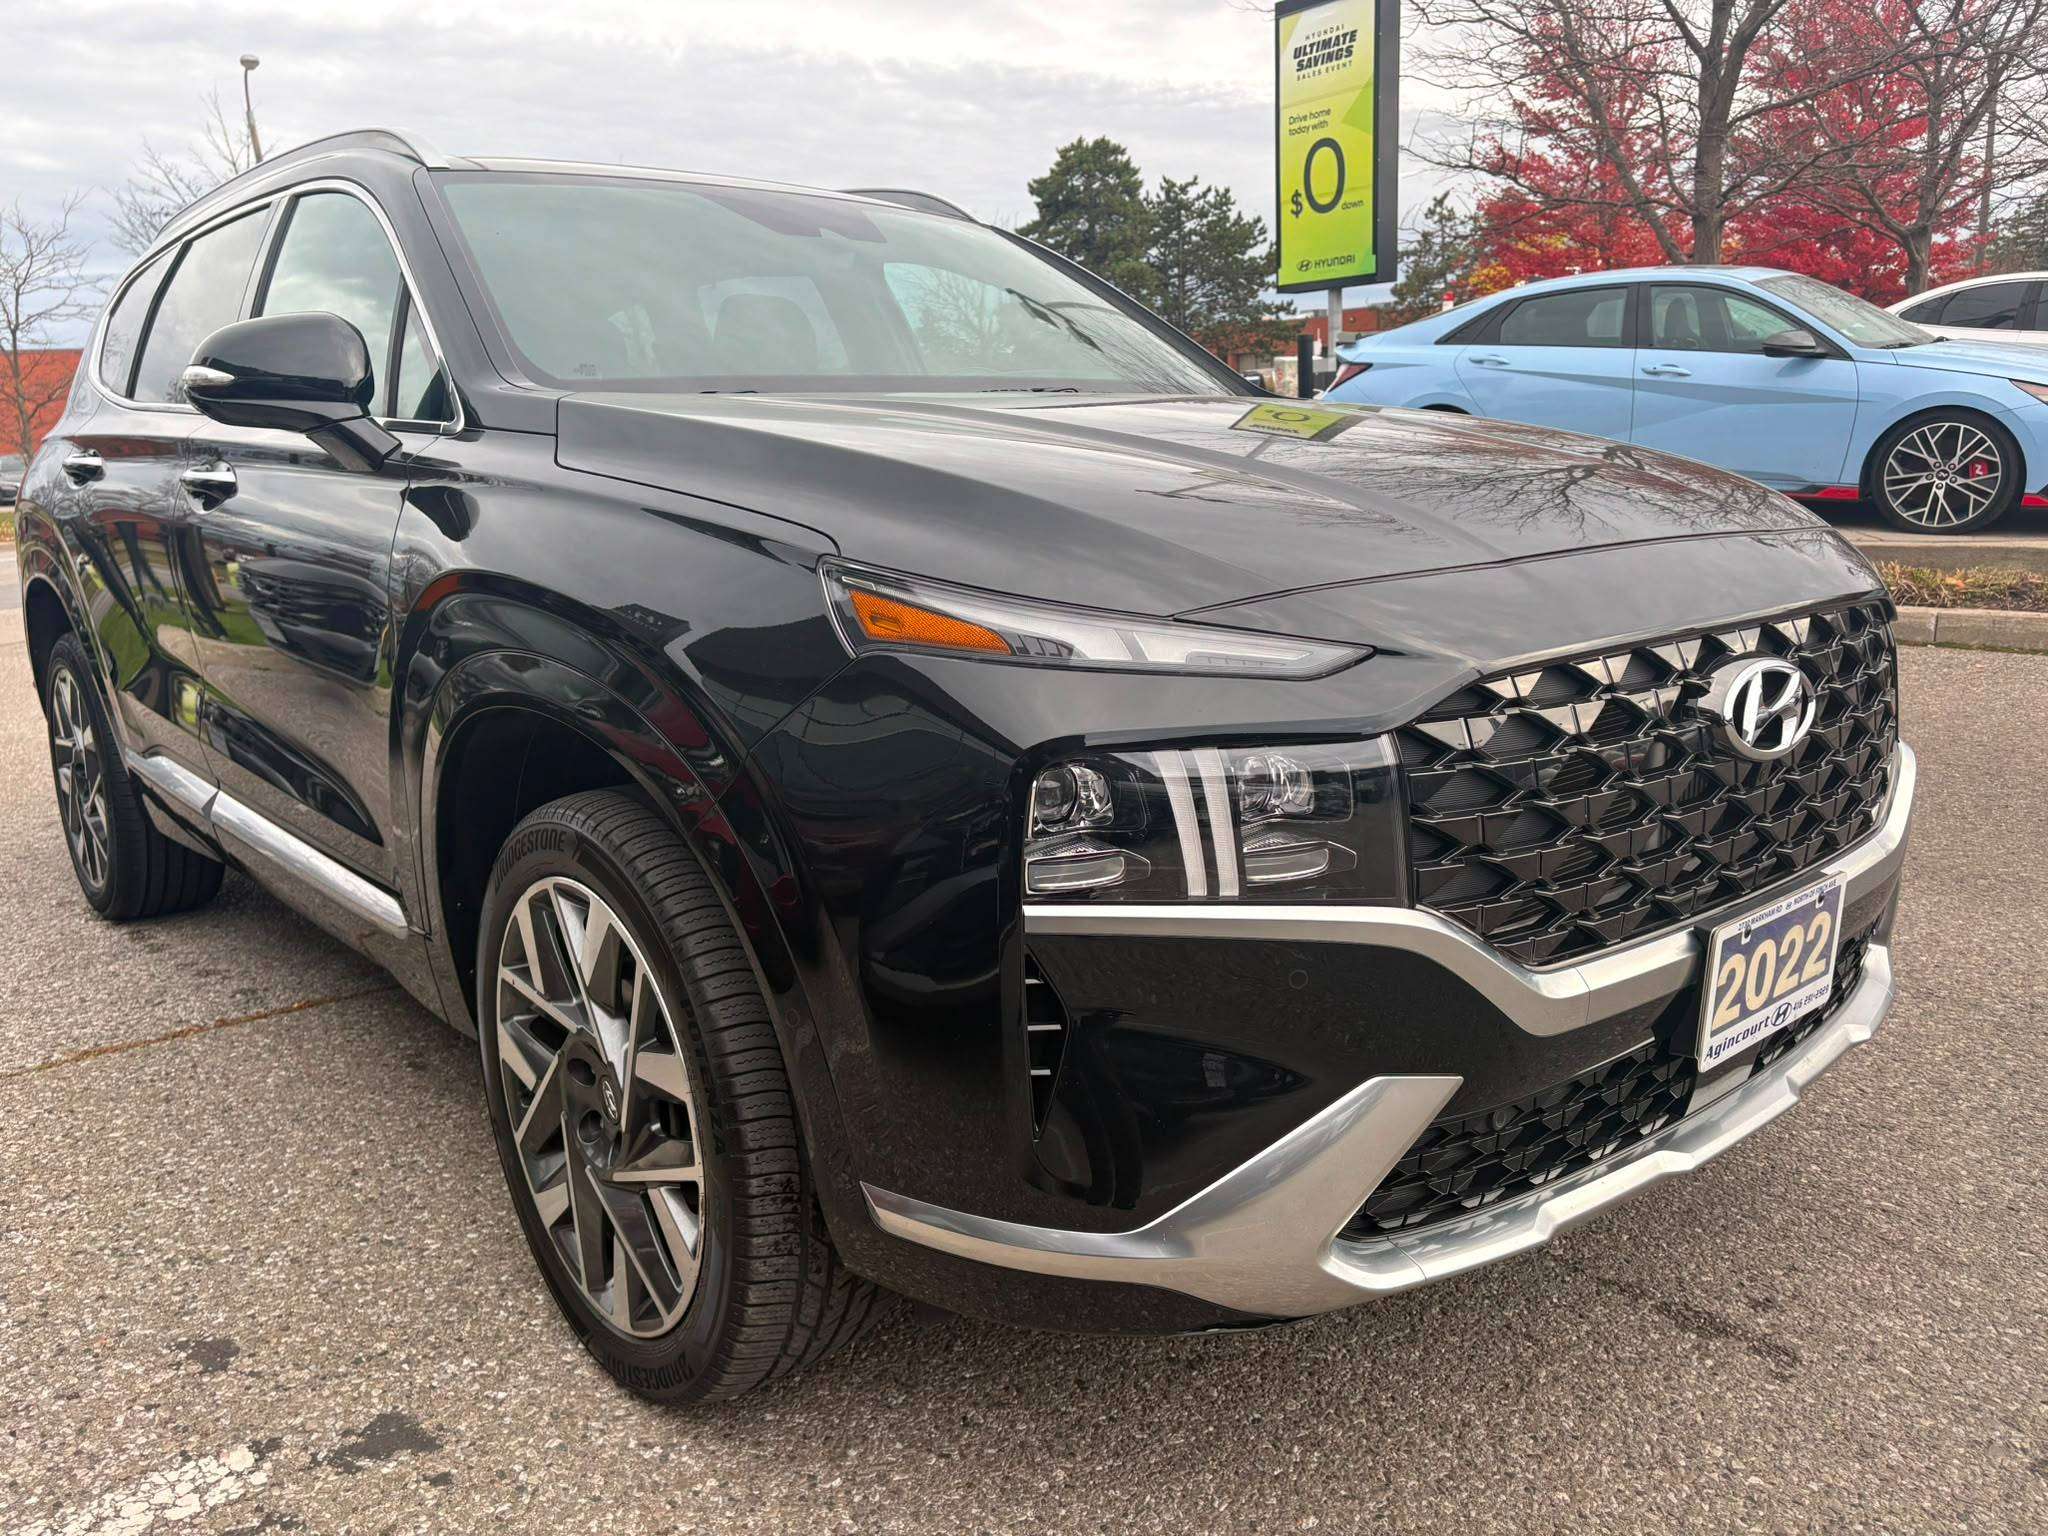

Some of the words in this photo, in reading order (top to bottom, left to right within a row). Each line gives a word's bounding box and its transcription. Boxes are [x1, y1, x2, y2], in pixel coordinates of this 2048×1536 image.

[1305, 24, 1346, 40] HYUNDAI
[1293, 29, 1358, 60] ULTIMATE
[1296, 45, 1354, 72] SAVINGS
[1297, 69, 1322, 81] SALES
[1325, 60, 1353, 74] EVENT
[1288, 113, 1308, 126] Drive
[1309, 108, 1332, 121] home
[1288, 124, 1310, 137] today
[1311, 120, 1329, 131] with
[1341, 199, 1365, 211] down
[1314, 254, 1356, 269] HYUNDAI
[1712, 911, 1832, 1030] 2022
[1704, 1016, 1770, 1061] Agincourt
